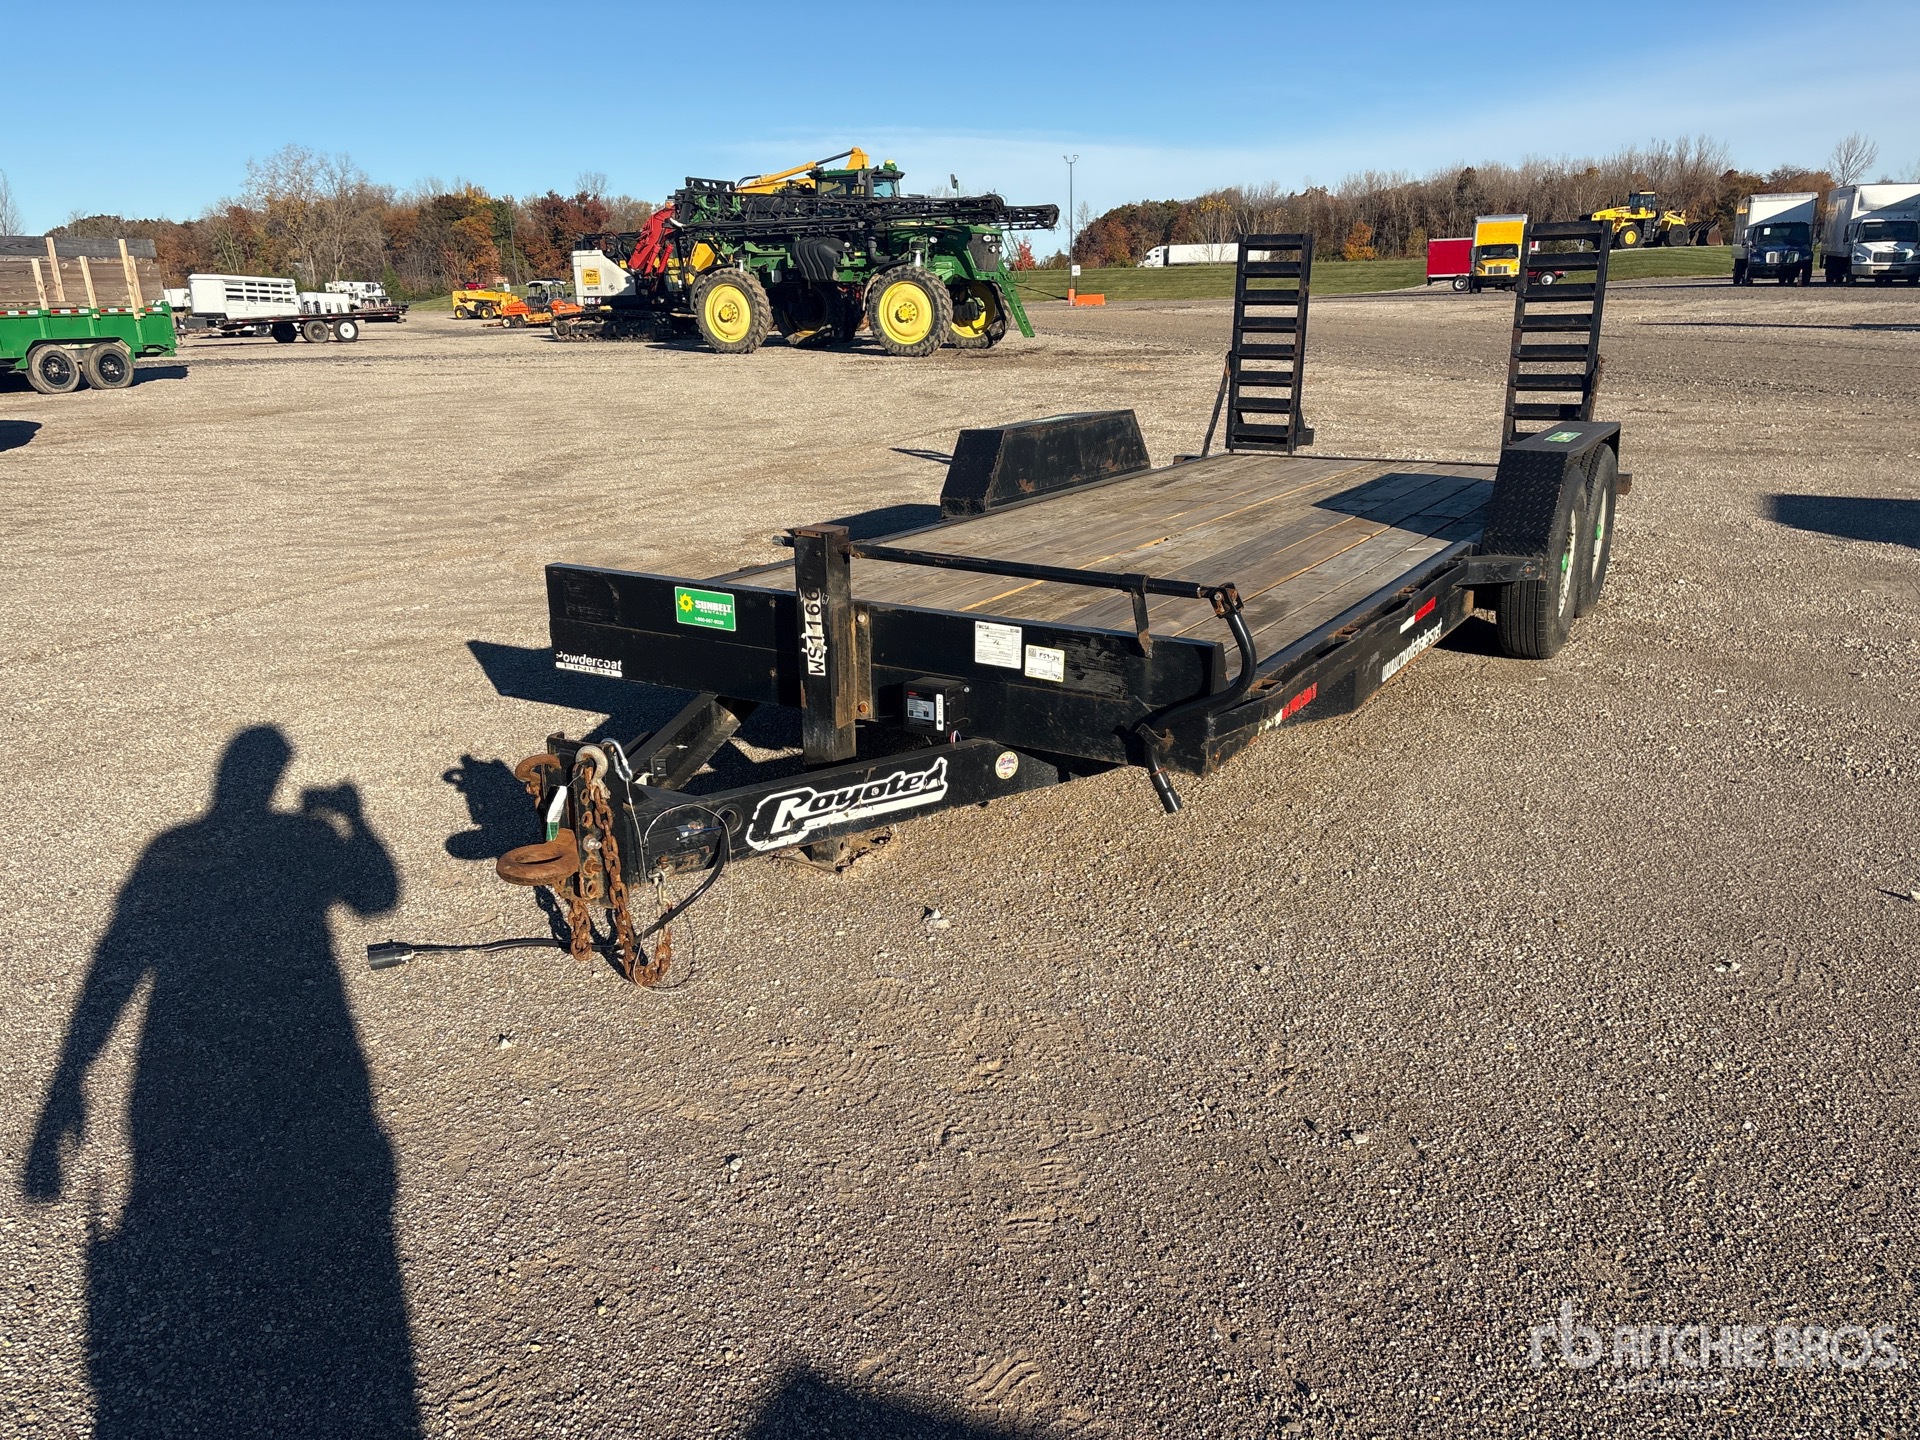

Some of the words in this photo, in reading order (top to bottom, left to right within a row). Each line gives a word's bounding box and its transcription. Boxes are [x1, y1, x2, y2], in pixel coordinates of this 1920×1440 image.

[694, 600, 732, 613] SUNBELT
[804, 589, 825, 674] WS1166
[746, 769, 928, 850] Coyote
